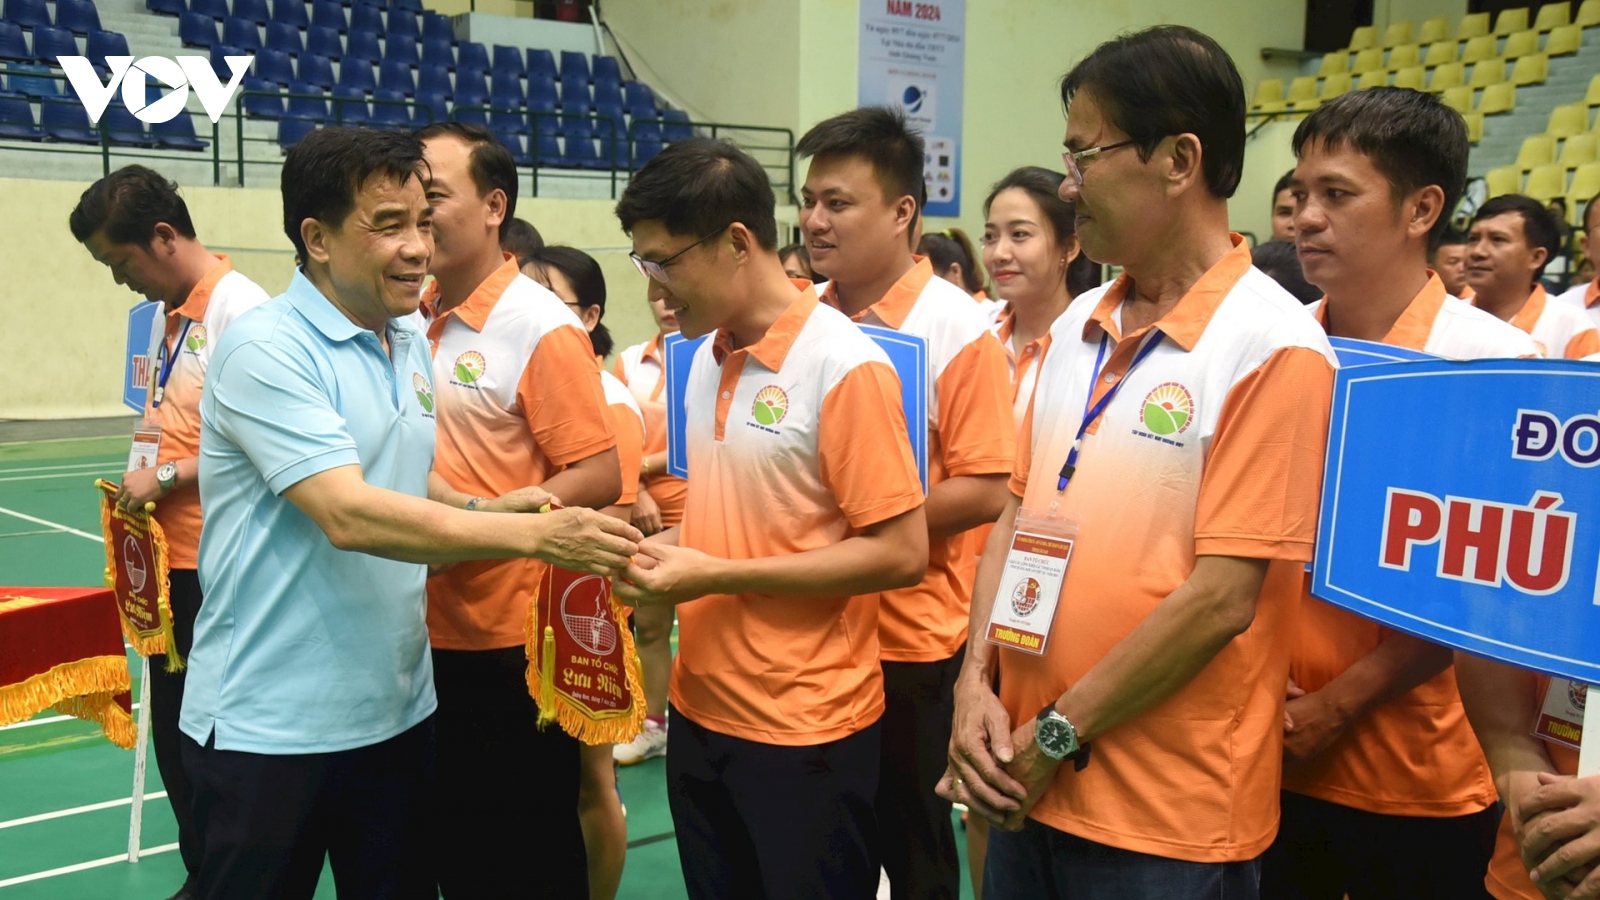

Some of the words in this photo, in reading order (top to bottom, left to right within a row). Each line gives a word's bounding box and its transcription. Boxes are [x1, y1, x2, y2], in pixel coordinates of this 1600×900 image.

[915, 3, 941, 20] 2024
[1513, 410, 1600, 467] ĐO
[1380, 488, 1575, 594] PHÚ
[1020, 632, 1040, 648] ĐOÀN
[571, 655, 589, 666] BAN
[591, 656, 602, 668] TỔ
[563, 668, 592, 689] Lưu
[597, 673, 622, 701] Niệm
[1547, 720, 1581, 741] TRƯỞNG
